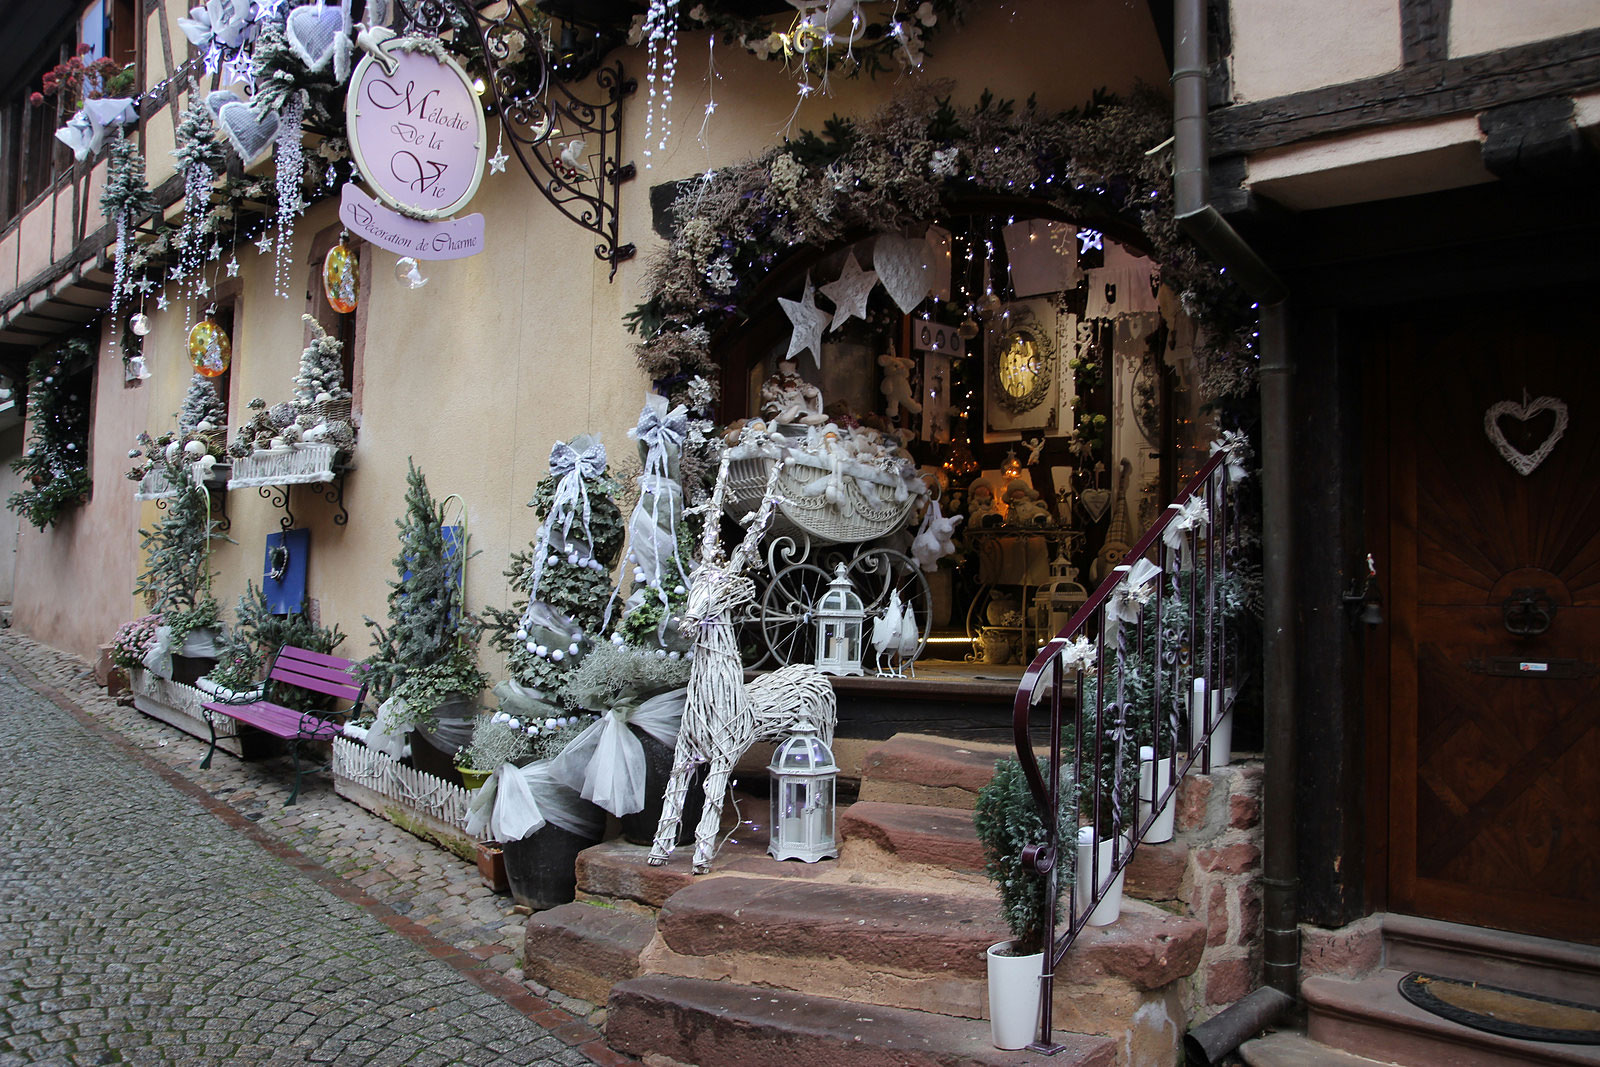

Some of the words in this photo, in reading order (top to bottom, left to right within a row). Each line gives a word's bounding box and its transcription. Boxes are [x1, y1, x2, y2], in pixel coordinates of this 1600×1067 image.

[367, 79, 470, 131] Mélodie
[391, 121, 424, 146] De
[428, 131, 444, 150] la
[390, 150, 448, 198] Vie
[346, 202, 412, 249] Décoration
[415, 237, 430, 252] de
[431, 231, 477, 252] Charme
